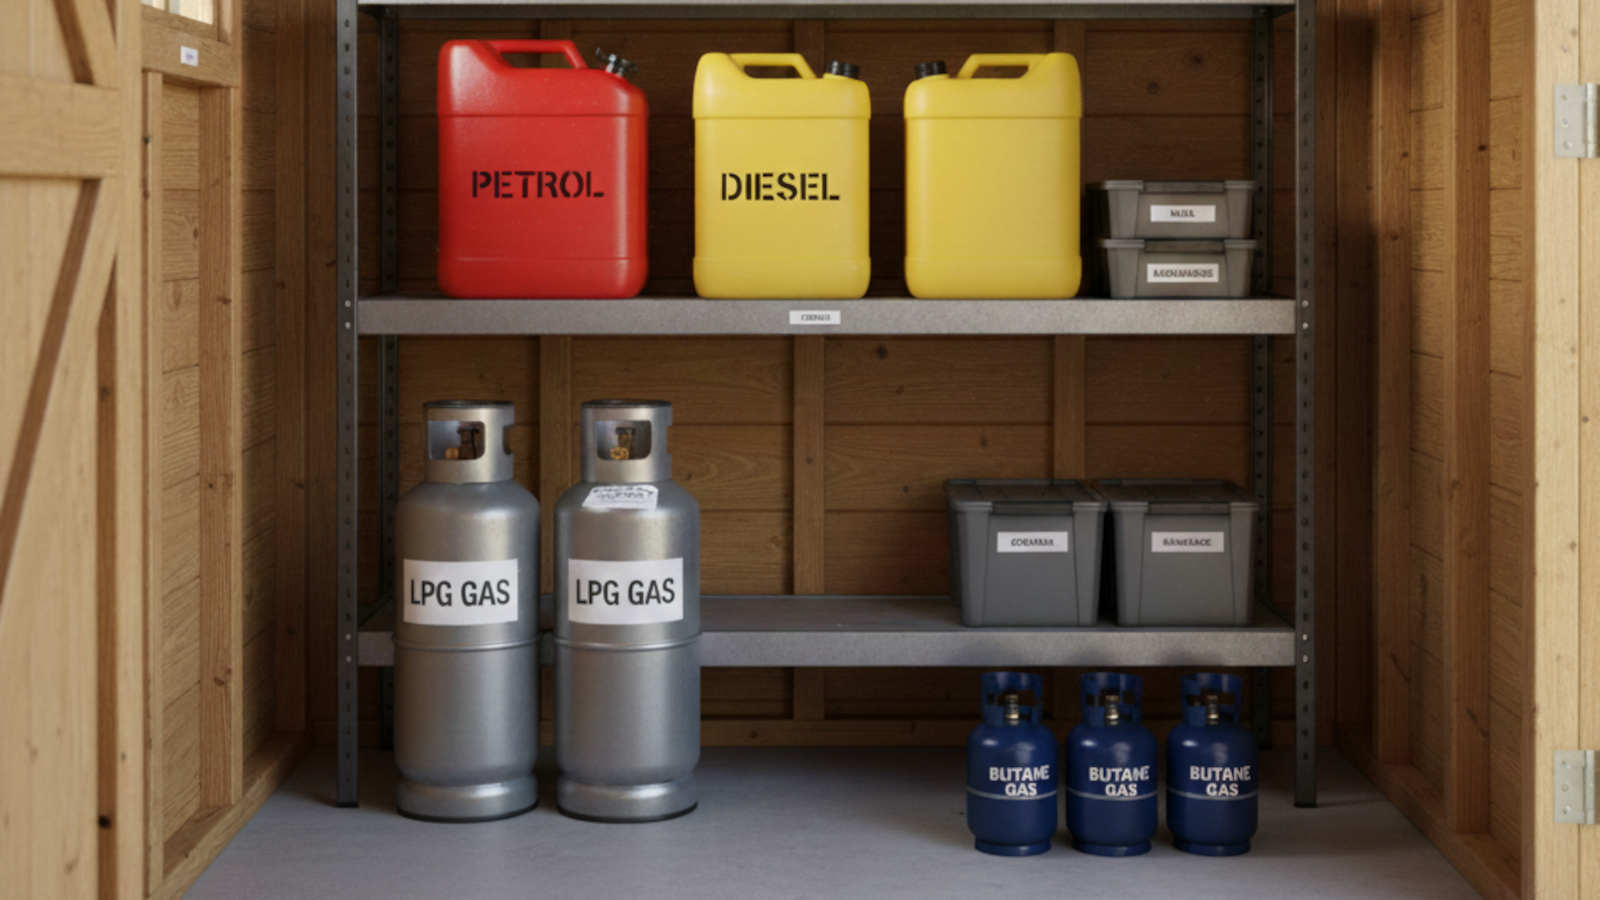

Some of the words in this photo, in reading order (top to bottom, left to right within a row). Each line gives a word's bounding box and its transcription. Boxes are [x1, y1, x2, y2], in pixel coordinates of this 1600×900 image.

[471, 170, 605, 199] PETROL
[721, 173, 840, 201] DIESEL
[410, 579, 453, 606] LPG
[461, 579, 511, 606] GAS
[576, 579, 620, 606] LPG
[627, 578, 675, 606] GAS
[1089, 765, 1150, 782] BUTANE
[1189, 765, 1251, 781] BUTANE
[1004, 782, 1038, 797] GAS
[1105, 782, 1138, 797] GAS
[1206, 782, 1239, 797] GAS
